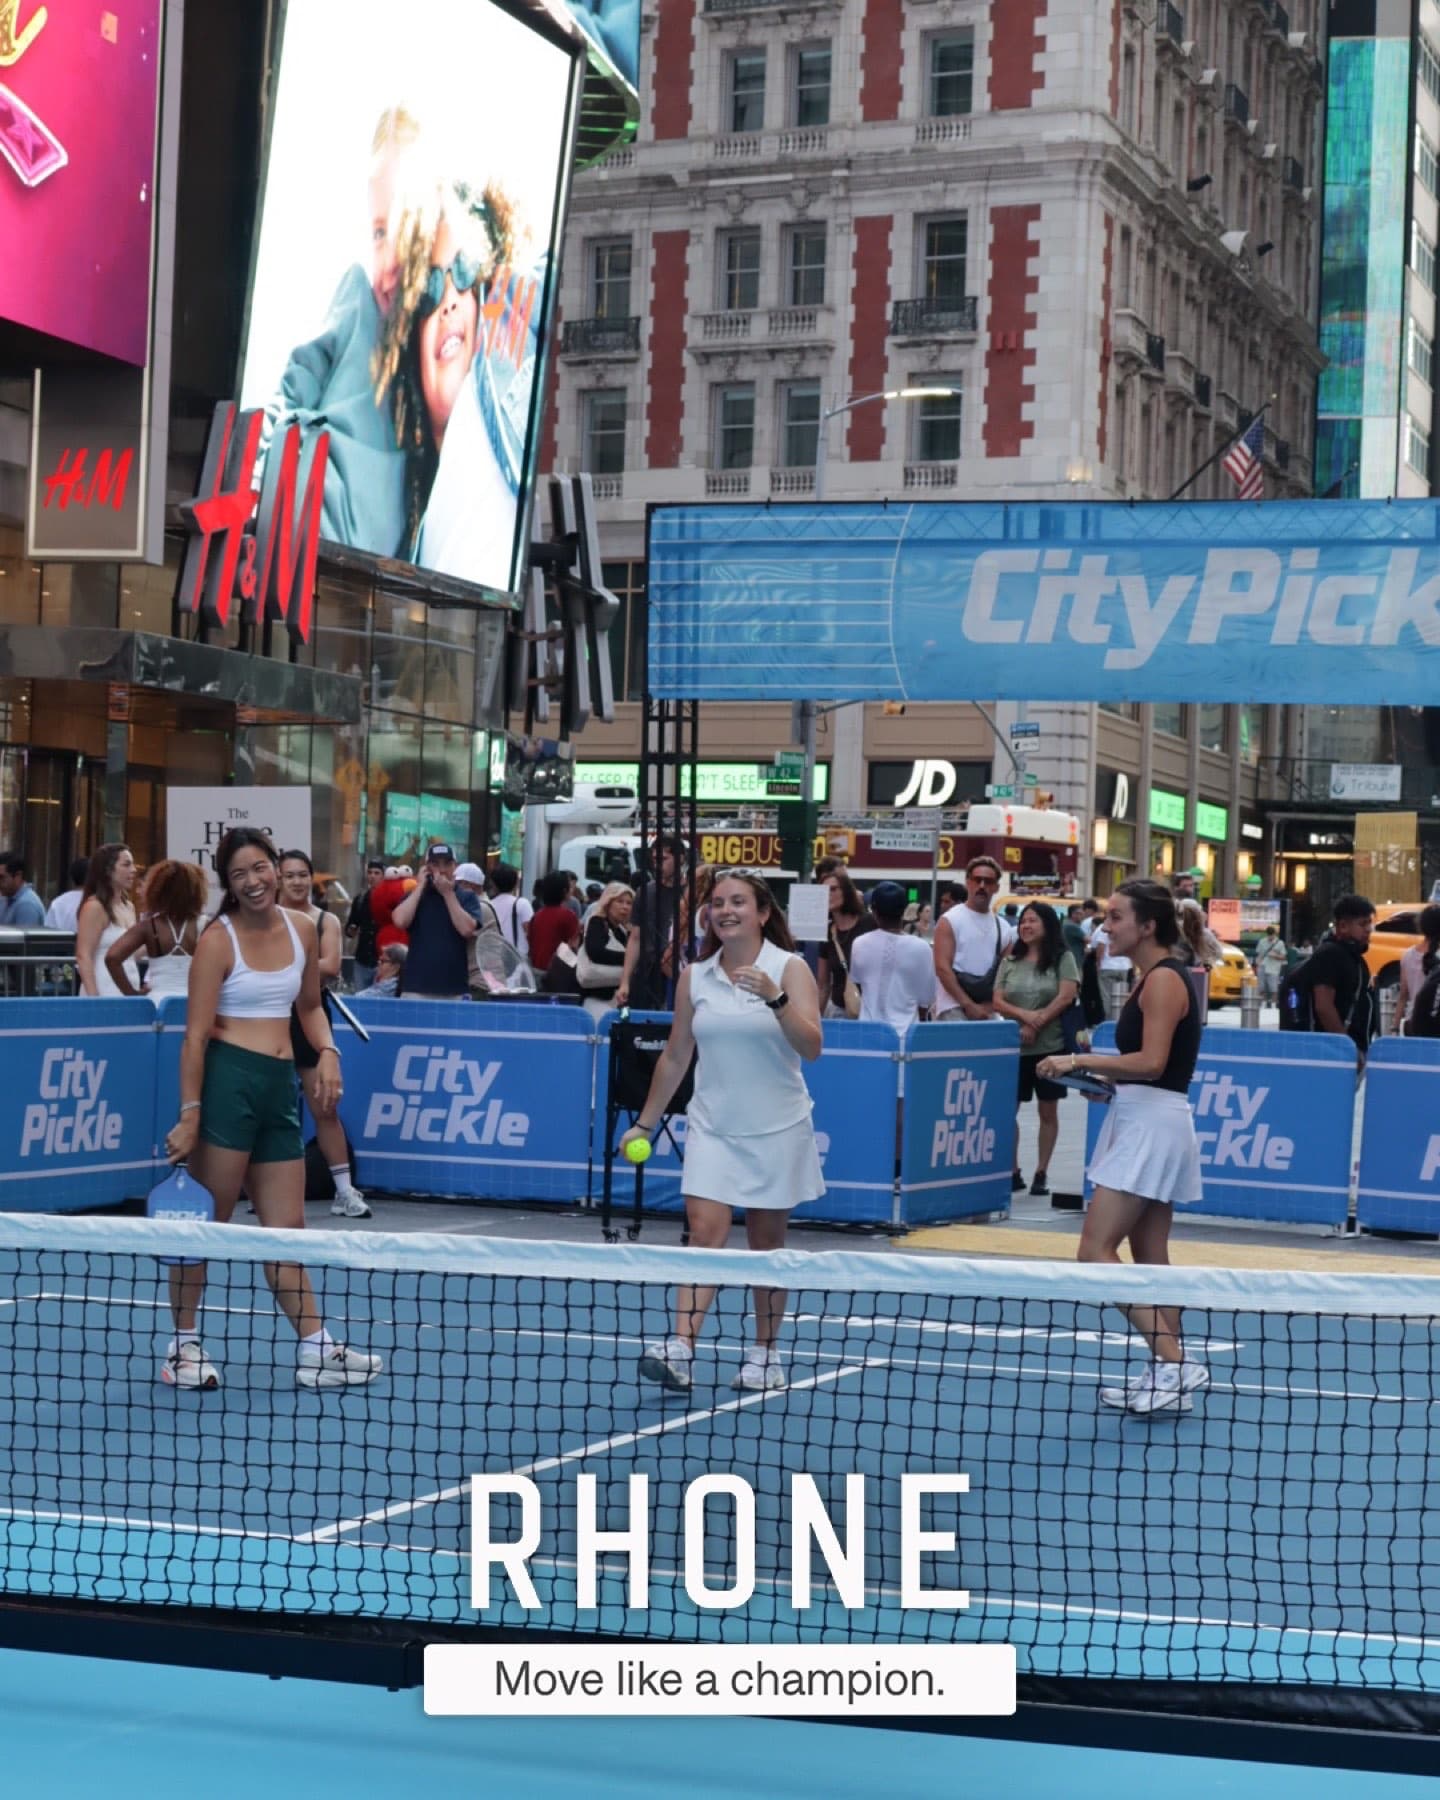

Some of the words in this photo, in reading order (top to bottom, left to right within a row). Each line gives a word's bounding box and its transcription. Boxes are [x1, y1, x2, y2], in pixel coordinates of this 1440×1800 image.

[44, 448, 134, 512] H&M
[190, 402, 331, 645] H&M
[894, 759, 957, 808] JD
[228, 807, 249, 819] The
[40, 1047, 108, 1111] City
[392, 1044, 503, 1106] City
[943, 1068, 988, 1126] City
[20, 1099, 123, 1157] Pickle
[362, 1092, 531, 1148] Pickle
[931, 1115, 995, 1168] Pickle
[1197, 1119, 1295, 1170] ckle
